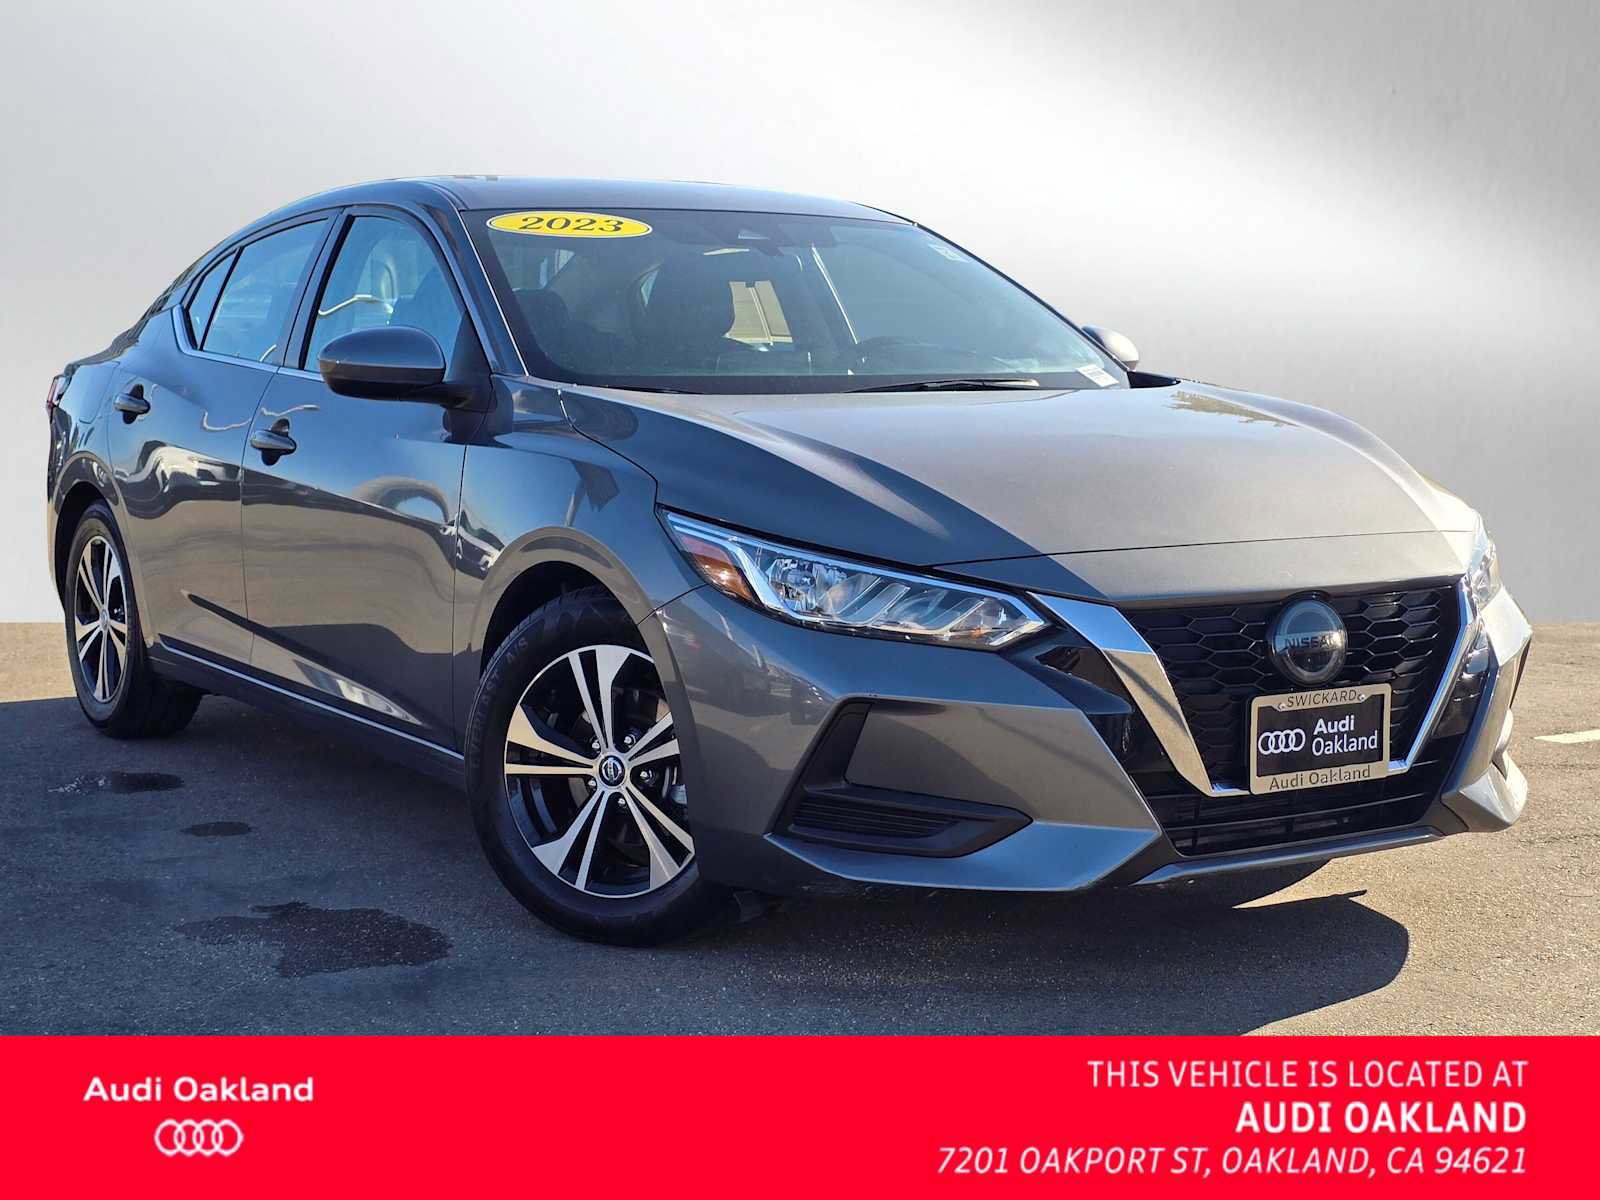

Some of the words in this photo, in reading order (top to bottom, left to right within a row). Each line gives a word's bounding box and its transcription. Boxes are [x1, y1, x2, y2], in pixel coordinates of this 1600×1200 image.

[519, 216, 624, 233] 2023
[1287, 689, 1357, 708] SWICKARD
[1313, 715, 1355, 735] Audi
[1311, 730, 1377, 756] Oakland
[1269, 774, 1303, 791] Audi
[1309, 765, 1371, 784] Oakland
